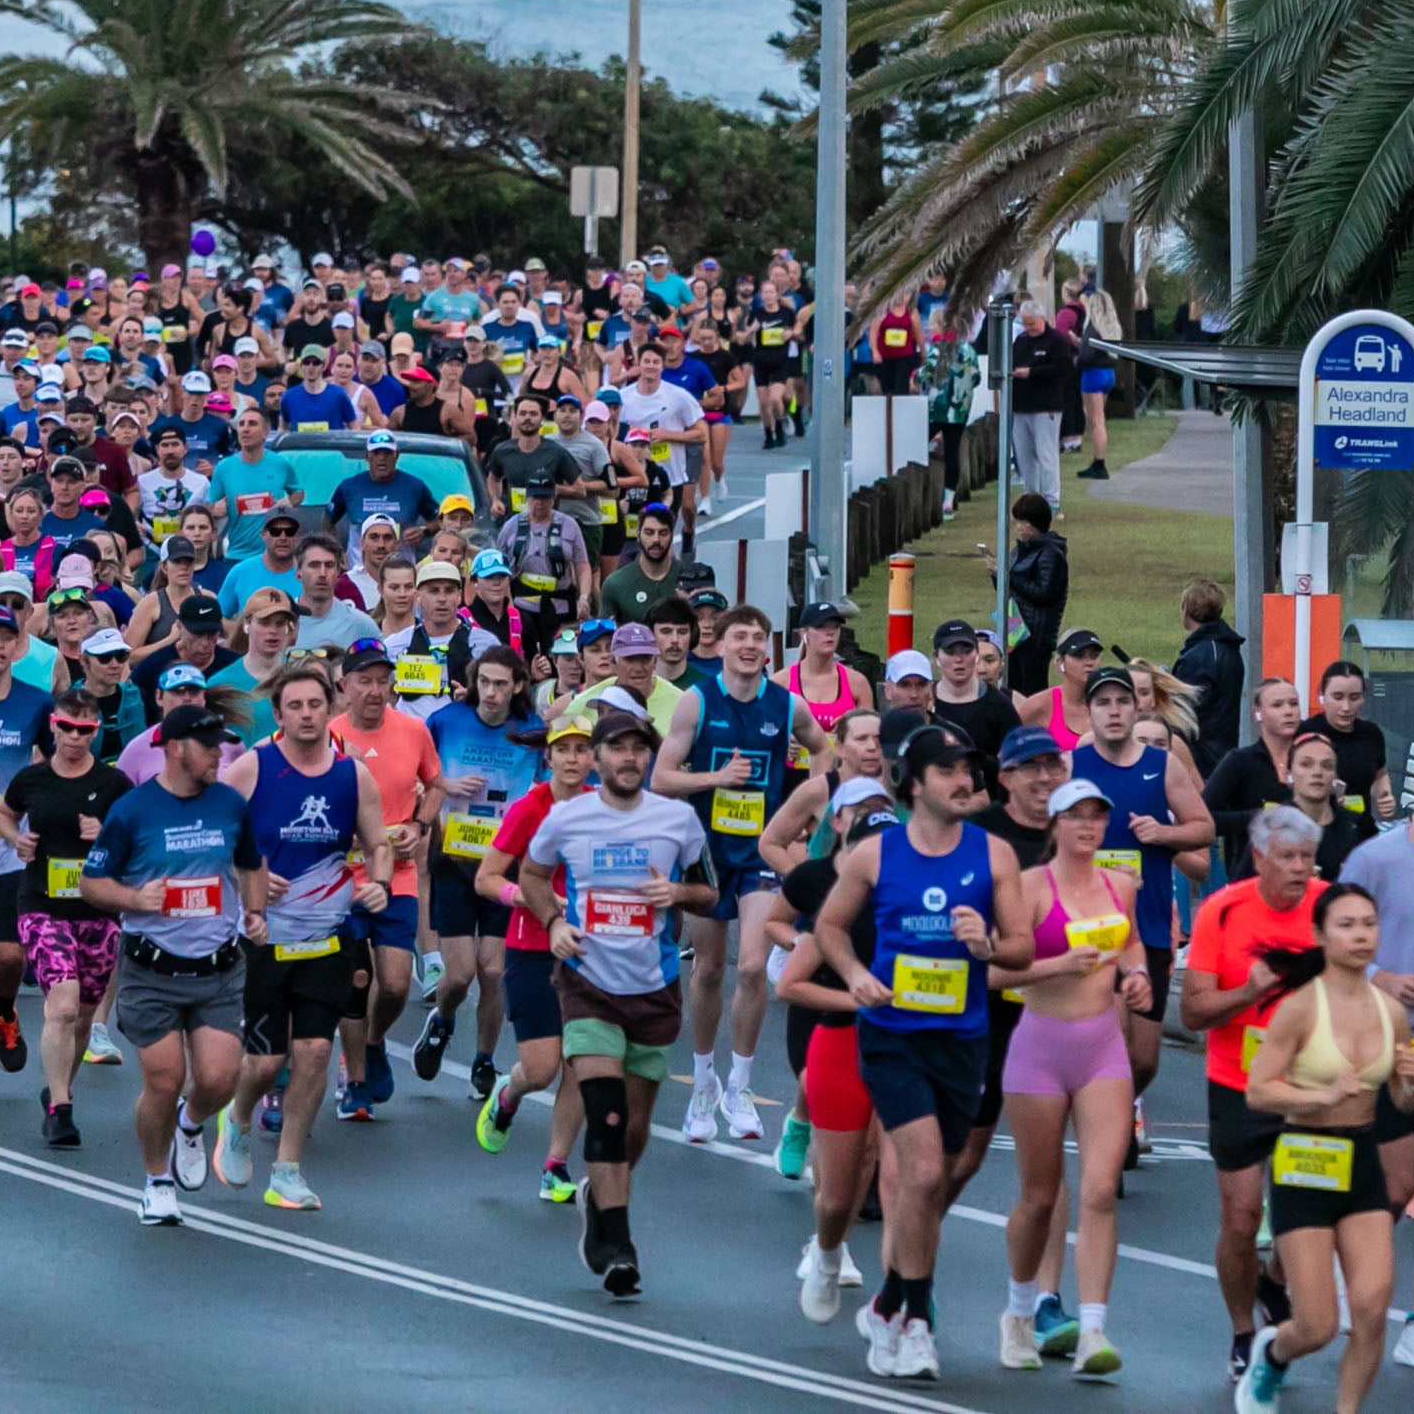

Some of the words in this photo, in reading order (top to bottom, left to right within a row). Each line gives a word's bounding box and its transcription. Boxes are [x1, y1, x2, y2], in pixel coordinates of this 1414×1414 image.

[1327, 387, 1409, 404] Alexandra
[1329, 406, 1407, 423] Headland
[409, 664, 423, 672] TEZ
[462, 754, 514, 766] MARATHON
[457, 824, 493, 837] JORDAN
[165, 836, 225, 852] MARATHON
[461, 834, 486, 845] 4067
[594, 901, 648, 916] GIANLUCA
